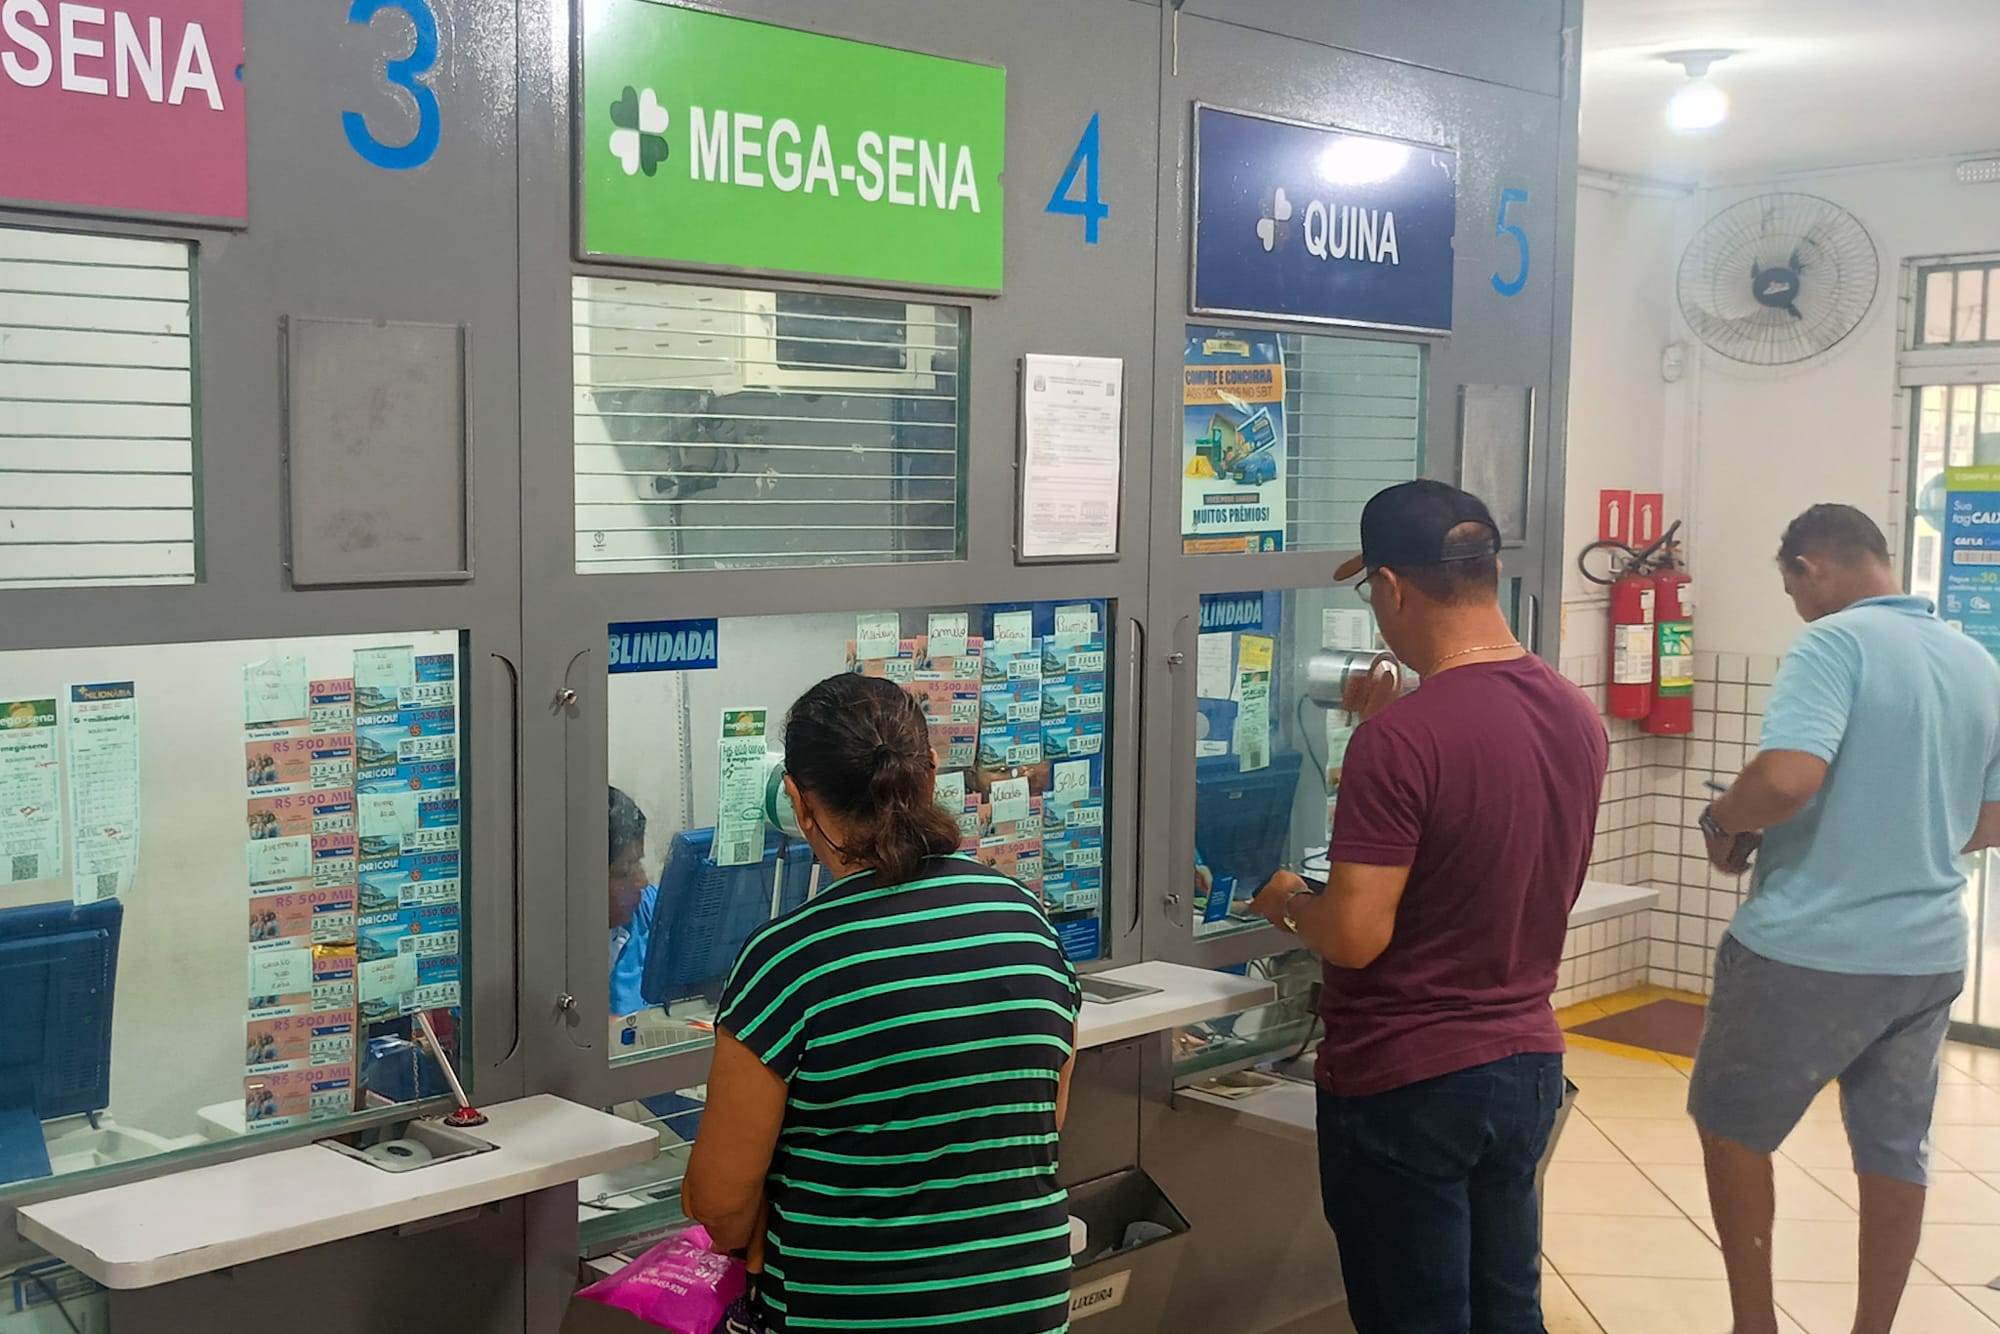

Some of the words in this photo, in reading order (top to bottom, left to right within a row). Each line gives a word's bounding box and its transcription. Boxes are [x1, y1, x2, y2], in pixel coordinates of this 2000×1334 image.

[1, 0, 224, 111] SENA
[341, 0, 441, 170] 3
[689, 105, 981, 214] MEGA-SENA
[1044, 112, 1109, 244] 4
[1303, 199, 1400, 265] QUINA
[1490, 188, 1531, 297] 5
[331, 681, 353, 692] MIL
[296, 738, 325, 751] 500
[330, 736, 354, 747] MIL
[298, 794, 326, 806] 500
[331, 791, 354, 802] MIL
[299, 892, 326, 905] 500
[332, 889, 355, 900] MIL
[296, 1015, 325, 1028] 500
[331, 1012, 354, 1024] MIL
[1071, 1287, 1113, 1311] LIXEIRA
